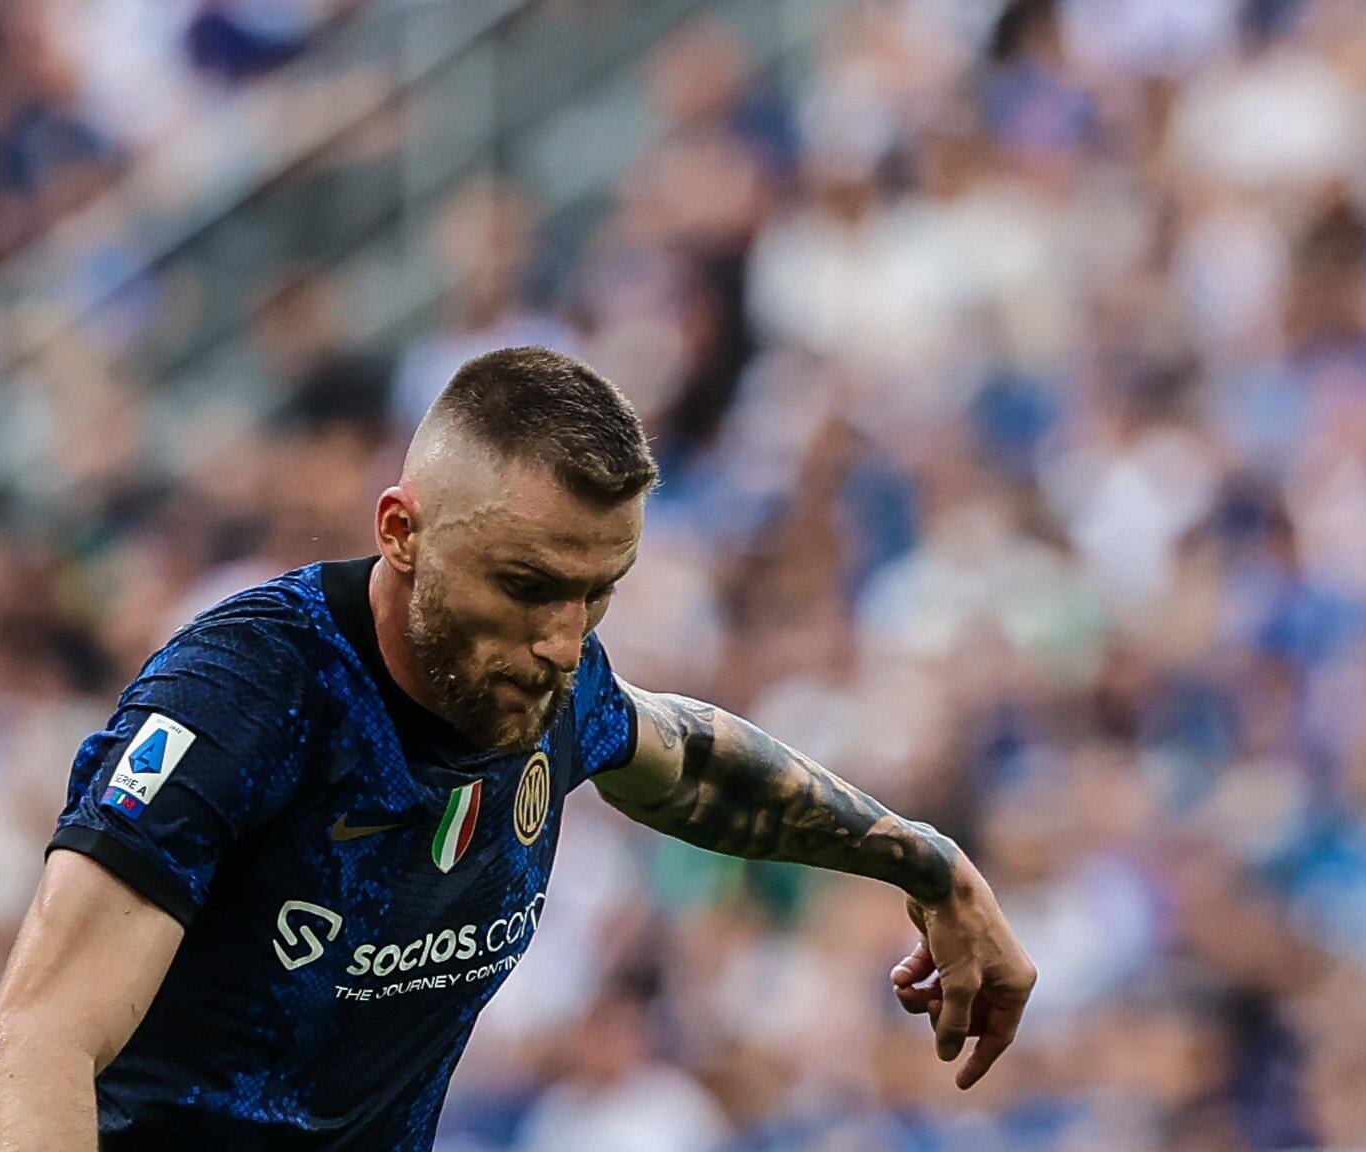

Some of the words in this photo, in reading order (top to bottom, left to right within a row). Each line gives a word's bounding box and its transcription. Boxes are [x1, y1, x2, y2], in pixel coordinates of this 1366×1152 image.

[136, 785, 148, 798] A
[335, 985, 373, 1001] THE
[375, 973, 461, 1000] JOURNEY
